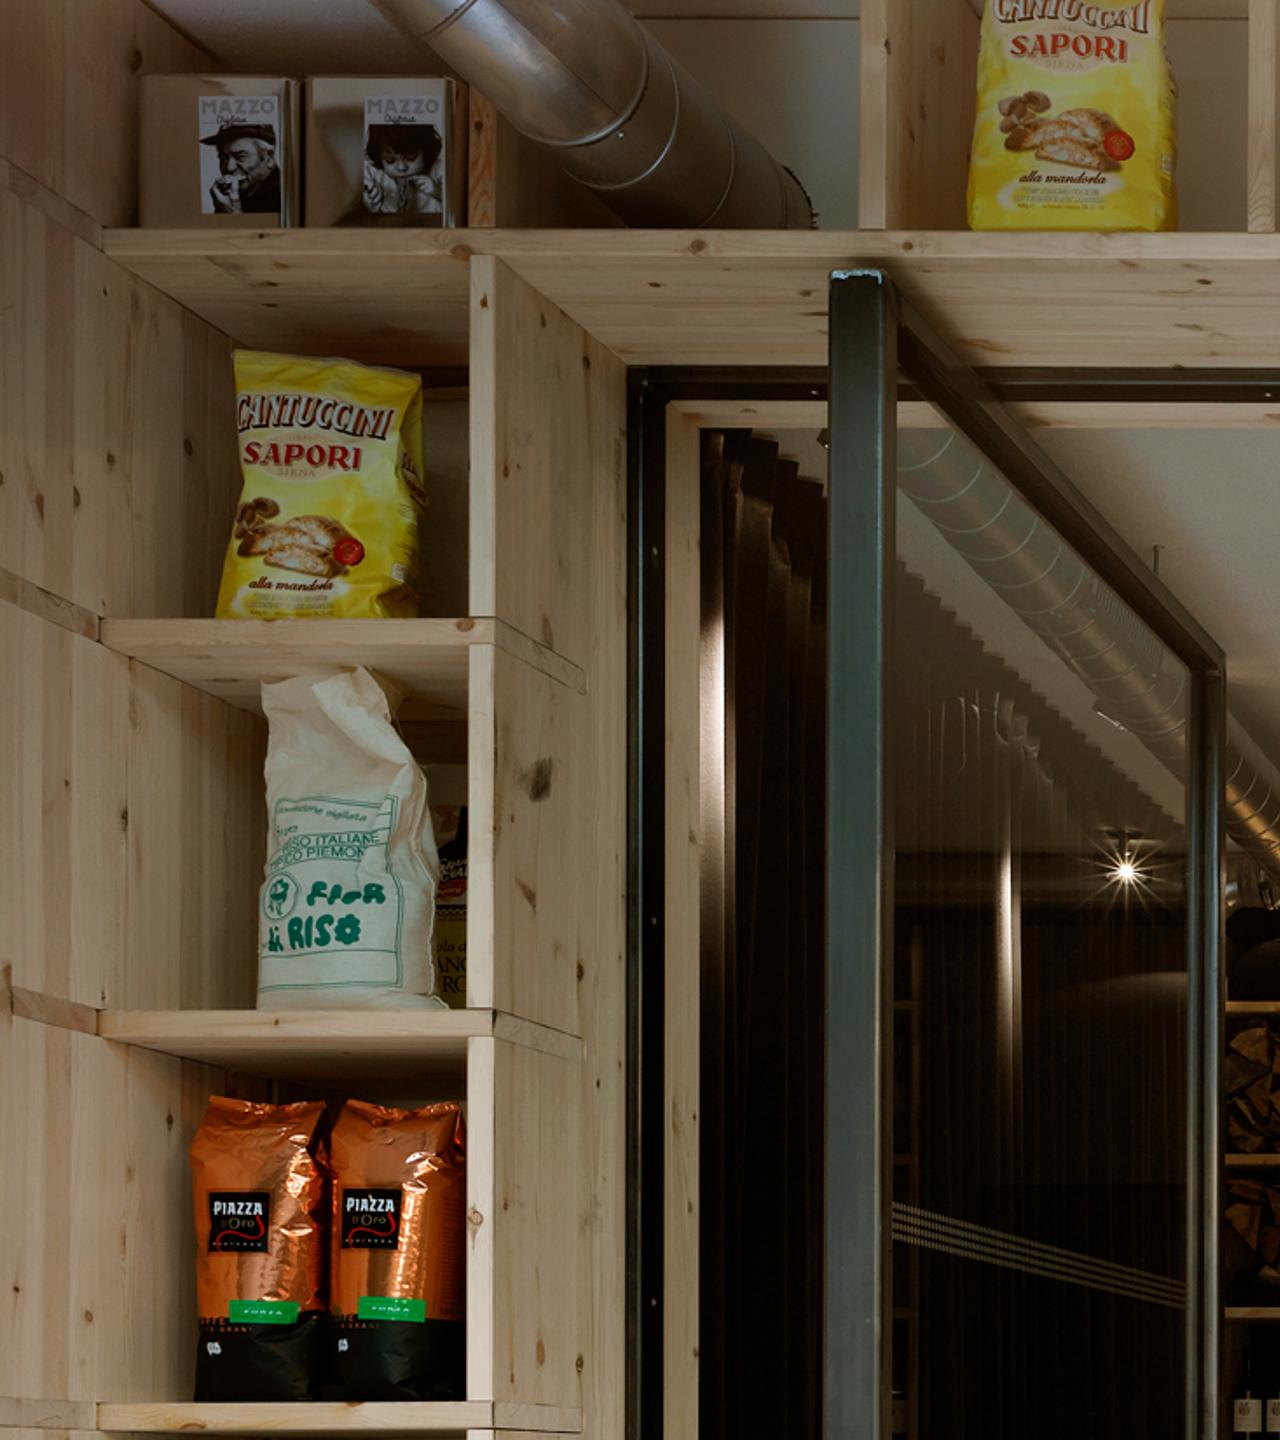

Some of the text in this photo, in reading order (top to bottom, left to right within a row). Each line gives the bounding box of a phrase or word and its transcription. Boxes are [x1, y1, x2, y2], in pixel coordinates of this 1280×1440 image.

[1009, 34, 1129, 63] SAPORI
[202, 99, 275, 115] MAZZO
[367, 98, 440, 115] MAZZO
[239, 394, 394, 441] CANTUCCINI
[243, 441, 362, 473] SAPORI
[287, 913, 362, 951] RISO
[212, 1200, 264, 1217] PIAZZA
[346, 1197, 396, 1213] PIAZZA
